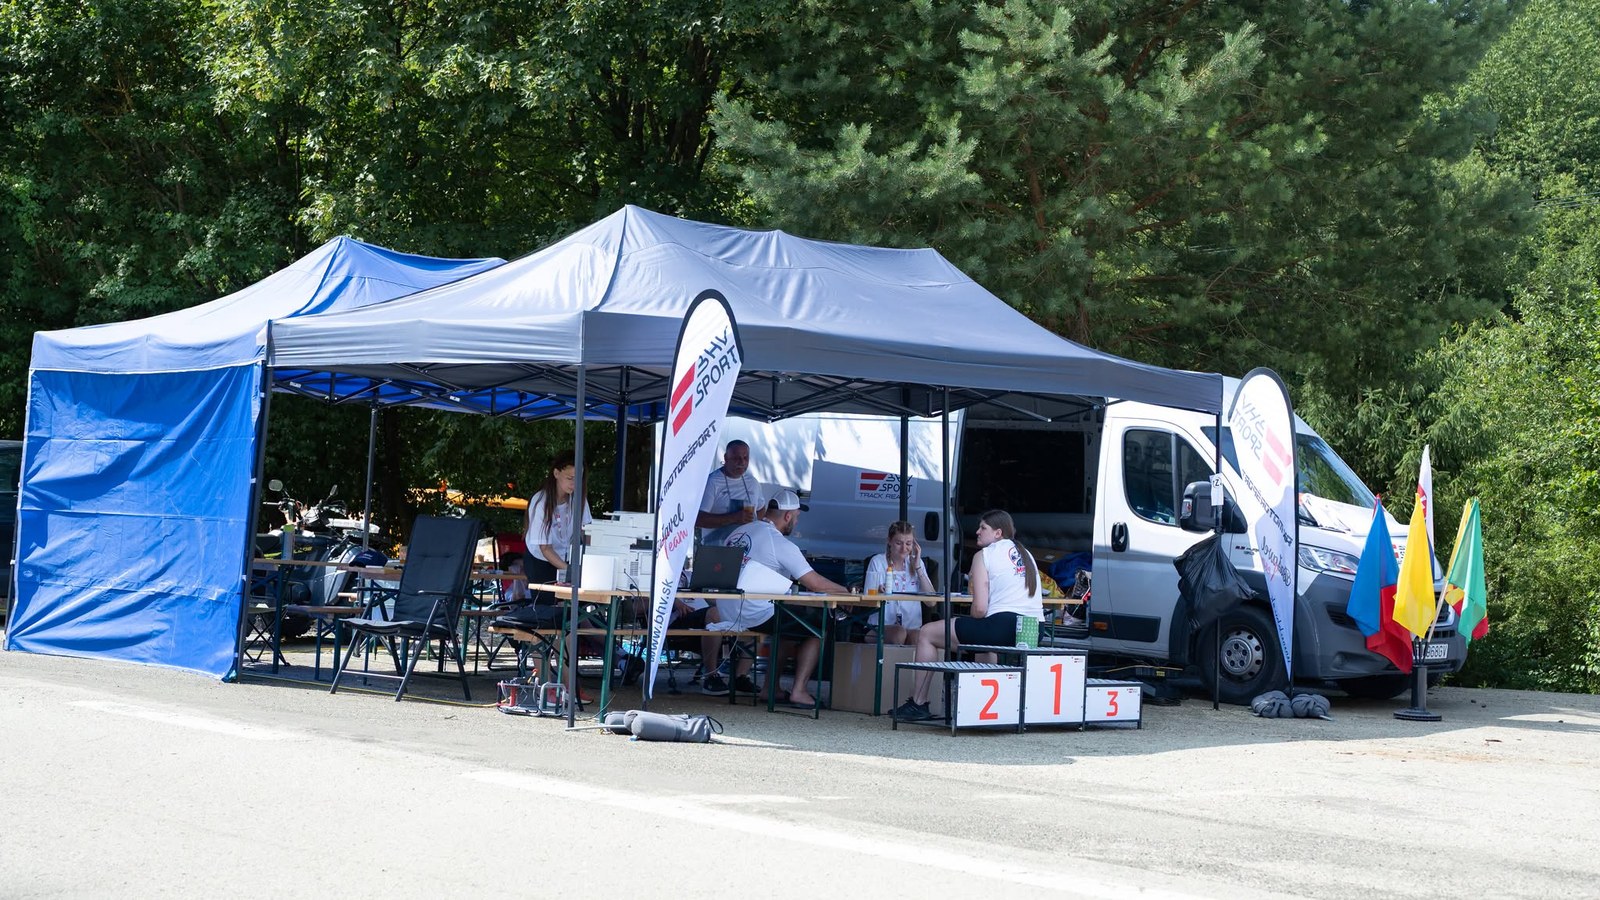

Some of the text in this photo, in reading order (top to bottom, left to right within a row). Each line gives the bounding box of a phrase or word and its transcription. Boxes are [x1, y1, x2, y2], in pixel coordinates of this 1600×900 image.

[697, 325, 729, 378] BHV
[695, 345, 738, 409] SPORT
[879, 483, 913, 493] SPOT
[979, 679, 999, 720] 2
[1050, 663, 1062, 715] 1
[1106, 691, 1119, 717] 3
